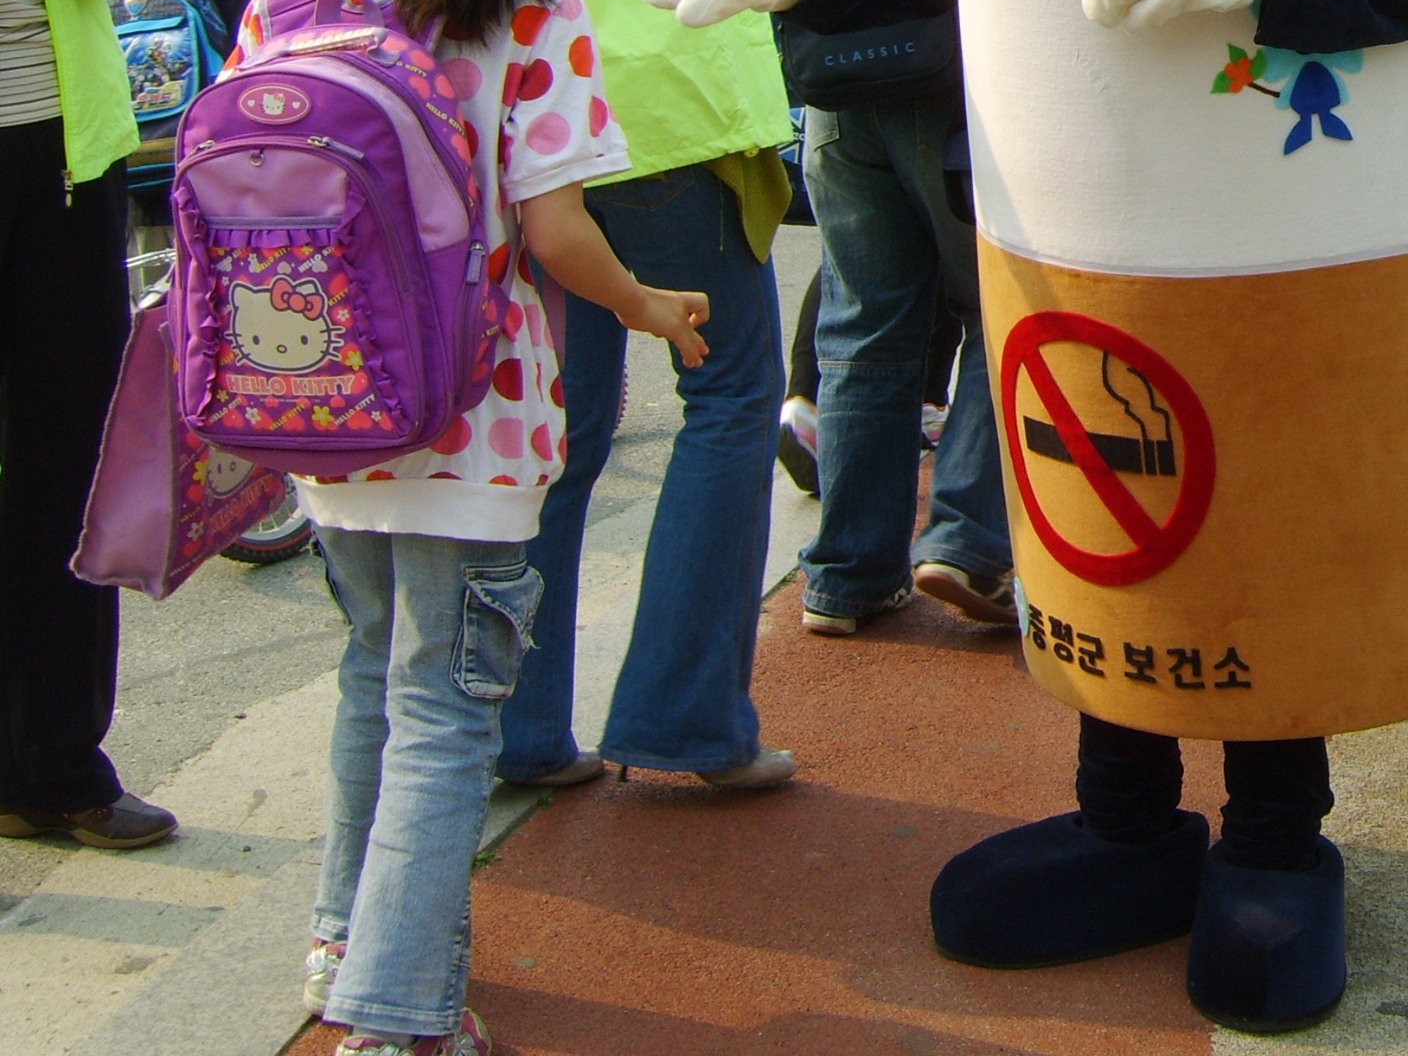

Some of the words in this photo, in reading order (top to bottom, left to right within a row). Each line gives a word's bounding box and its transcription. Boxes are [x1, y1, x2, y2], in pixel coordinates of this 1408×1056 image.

[825, 42, 915, 65] CLASSIC
[298, 253, 322, 273] HELLO
[226, 374, 286, 396] HELLO
[291, 375, 355, 396] KITTY
[335, 408, 356, 427] HELLO
[355, 393, 376, 412] KITTY
[1028, 603, 1106, 677] 증평군
[1123, 642, 1252, 690] 보건소
